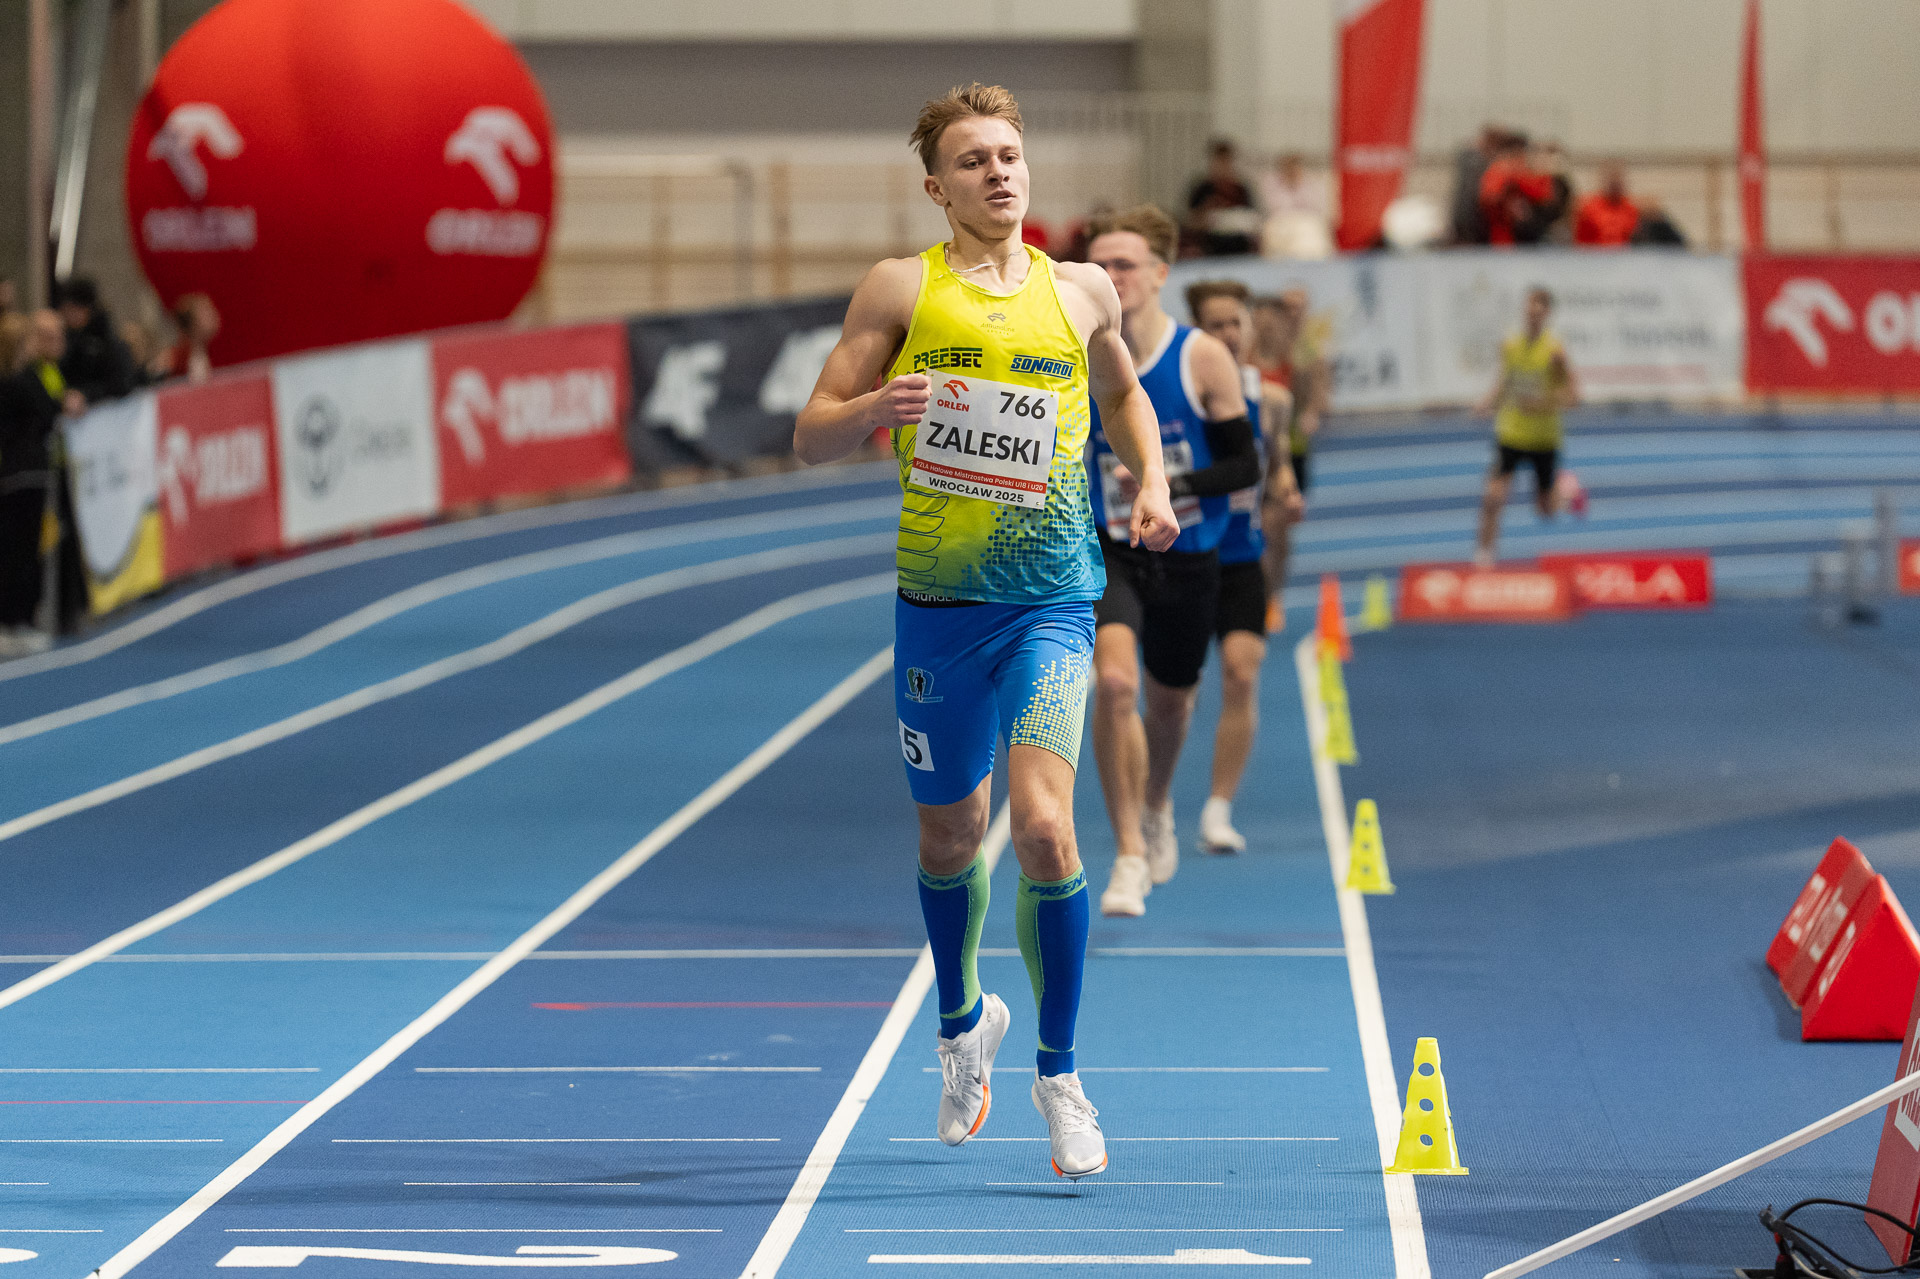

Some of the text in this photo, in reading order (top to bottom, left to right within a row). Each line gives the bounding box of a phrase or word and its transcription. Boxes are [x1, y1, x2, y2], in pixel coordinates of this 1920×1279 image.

[1010, 355, 1074, 378] SONAROL
[936, 391, 1046, 420] ORLEN 766
[925, 420, 1041, 466] ZALESKI
[915, 460, 930, 470] PZLA
[930, 464, 953, 476] Halowe
[954, 470, 994, 484] Mistrzostwa
[994, 478, 1014, 488] Polski
[1030, 483, 1044, 491] U20
[928, 476, 1025, 503] WROCŁAW 2025
[903, 726, 923, 765] 5
